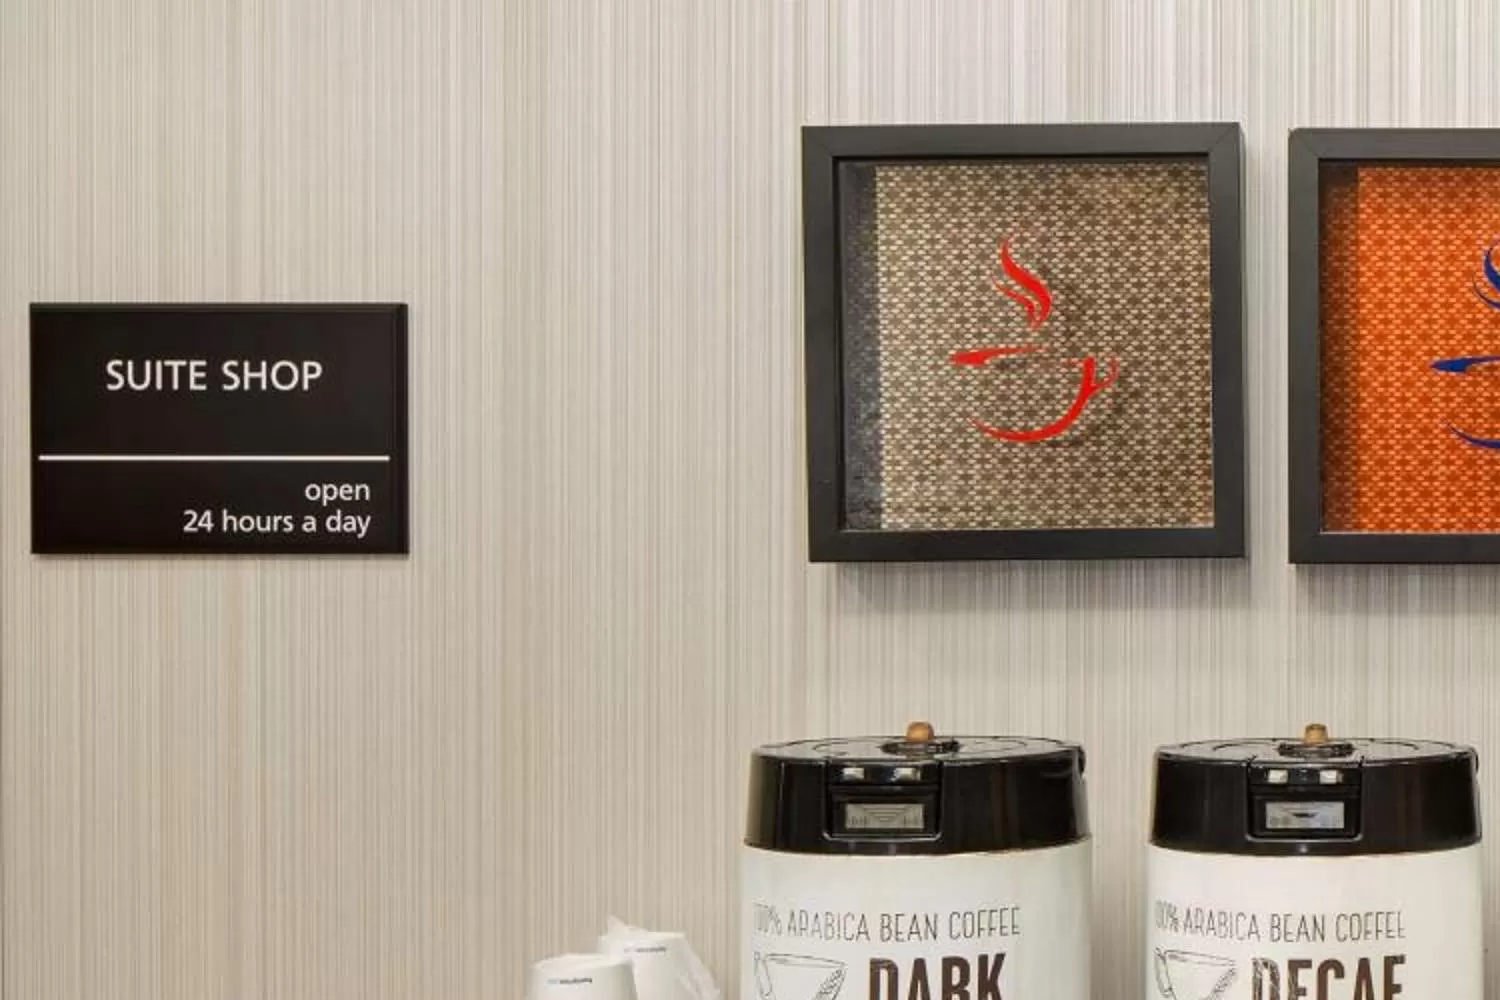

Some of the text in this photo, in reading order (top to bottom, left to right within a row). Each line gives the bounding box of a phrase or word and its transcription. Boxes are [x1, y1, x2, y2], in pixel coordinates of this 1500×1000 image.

[106, 359, 323, 391] SUITE SHOP
[304, 483, 370, 506] open
[183, 509, 371, 539] 24 hours a day
[788, 908, 871, 941] ARABICA
[880, 912, 938, 942] BEAN
[949, 906, 1020, 940] COFFEE
[1183, 905, 1261, 942] ARABICA
[1269, 912, 1325, 943] BEAN
[1335, 910, 1406, 943] COFFEE
